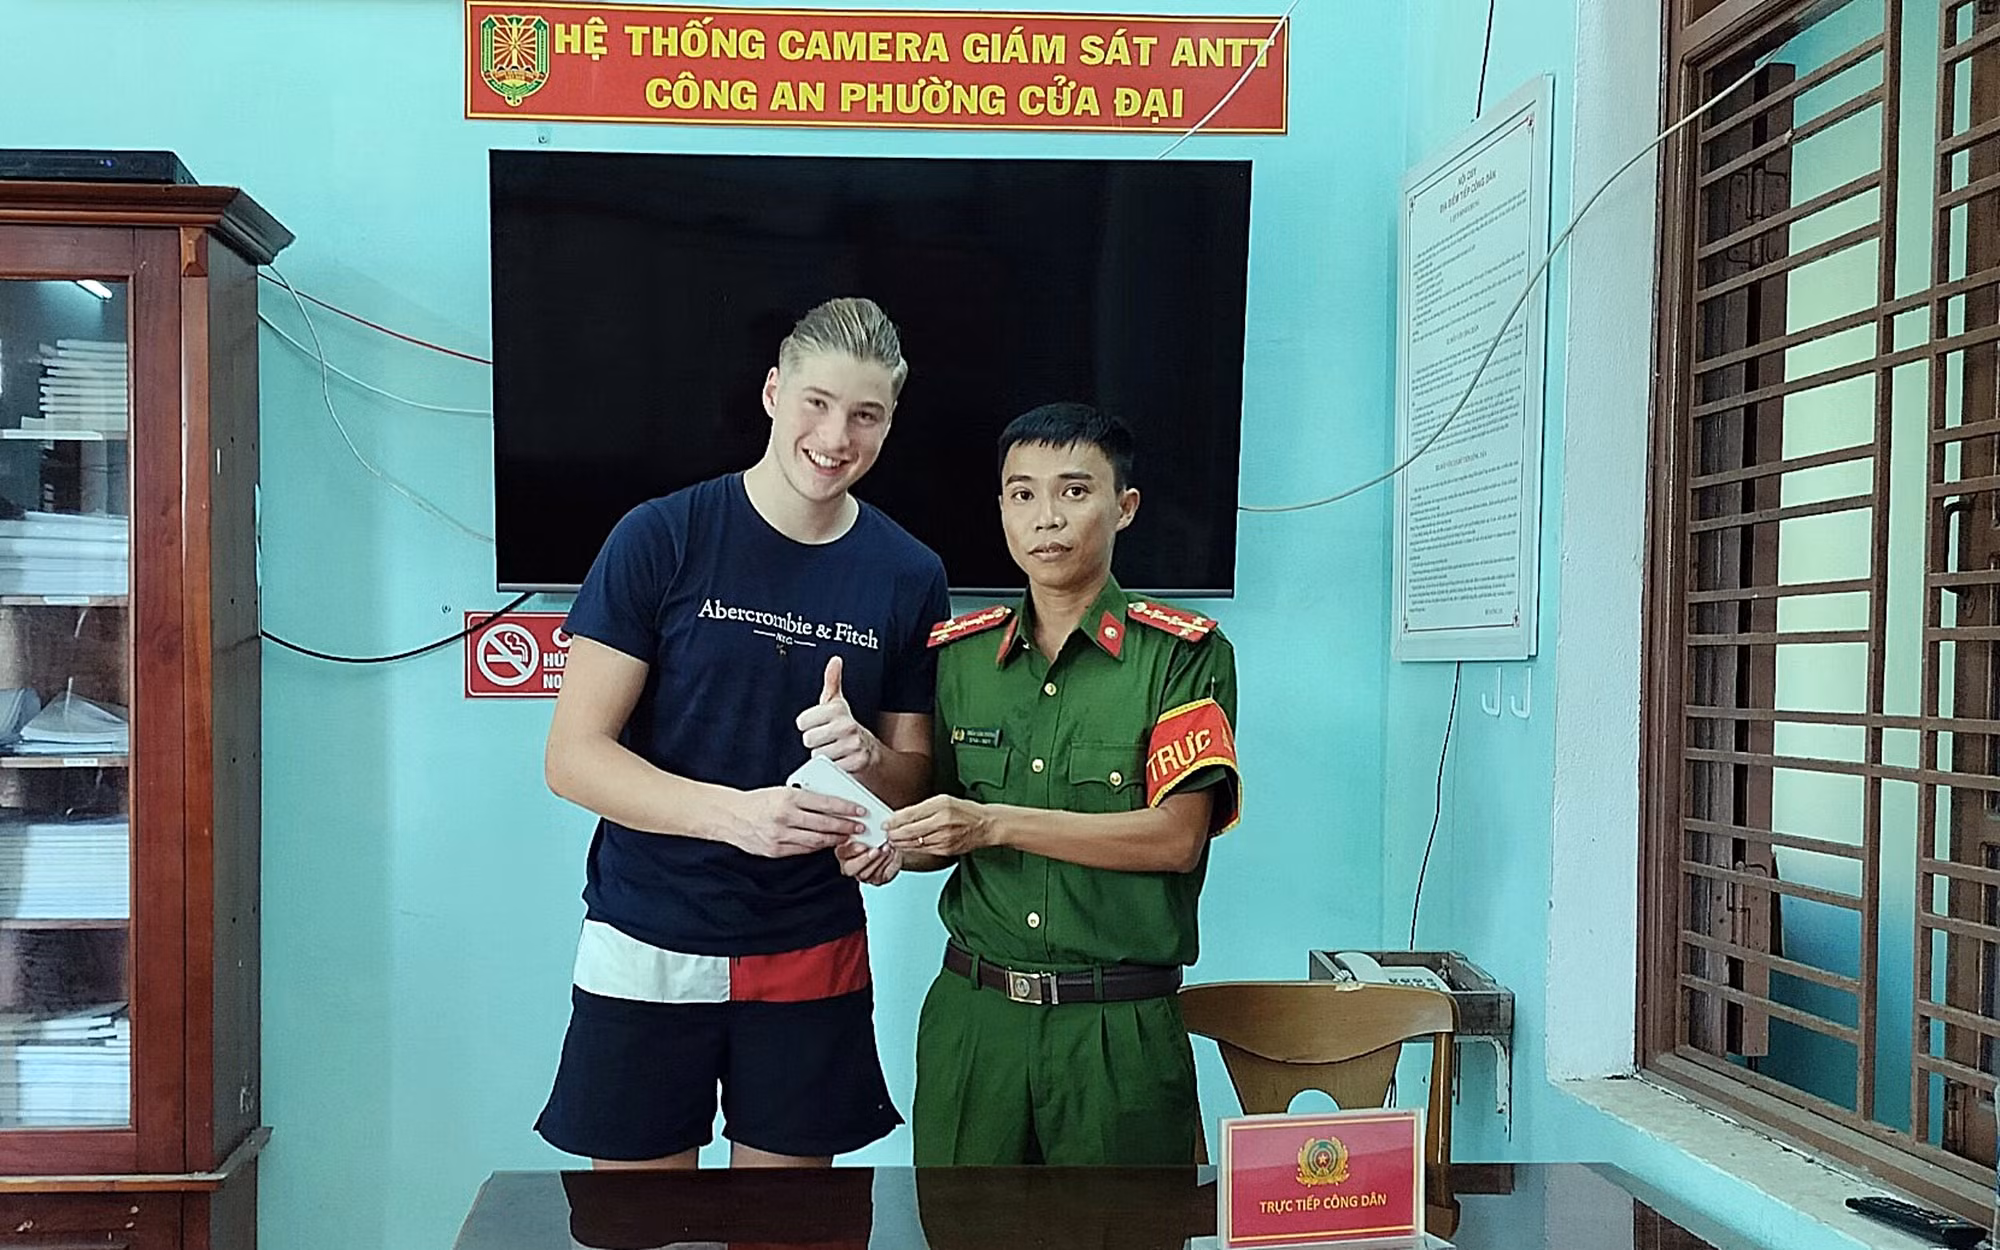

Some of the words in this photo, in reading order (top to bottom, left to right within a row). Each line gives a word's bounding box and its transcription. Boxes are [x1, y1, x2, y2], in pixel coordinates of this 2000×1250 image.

[554, 16, 608, 61] HỆ
[624, 16, 766, 60] THỐNG
[778, 29, 950, 63] CAMERA
[962, 25, 1067, 65] GIÁM
[1079, 28, 1159, 67] SÁT
[1170, 36, 1276, 68] ANTT
[645, 71, 758, 111] CÔNG
[769, 81, 826, 112] AN
[839, 76, 1007, 116] PHƯỜNG
[1018, 74, 1101, 117] CỬA
[1113, 86, 1185, 124] ĐẠI
[698, 599, 813, 635] Abercrombie
[815, 624, 832, 640] &
[833, 622, 879, 650] Fitch
[543, 650, 568, 667] HÚ
[543, 674, 563, 689] NO
[1146, 729, 1211, 782] TRỰC
[1259, 1199, 1293, 1215] TRỰC
[1296, 1194, 1320, 1211] TIẾP
[1323, 1194, 1358, 1209] CÔNG
[1361, 1191, 1387, 1207] DÂN
